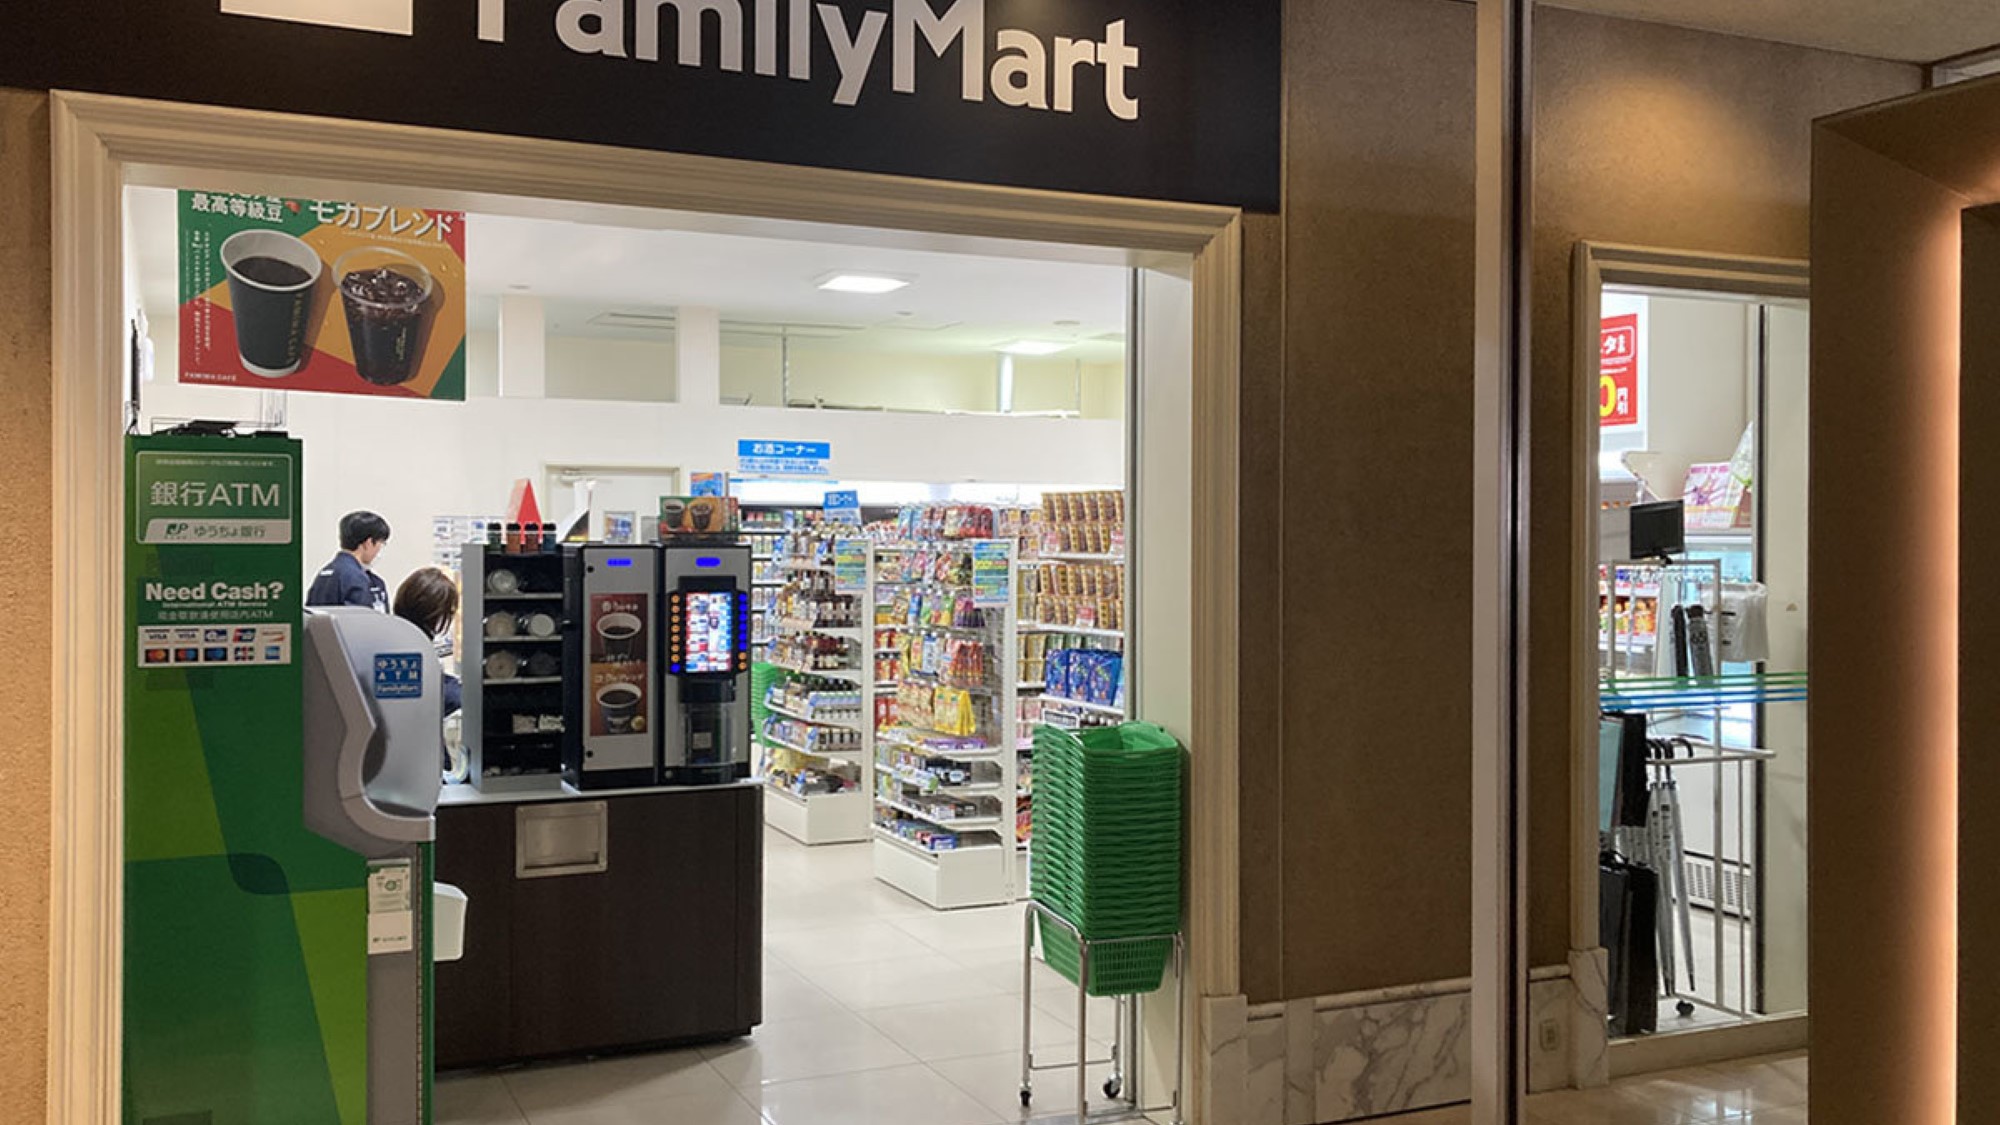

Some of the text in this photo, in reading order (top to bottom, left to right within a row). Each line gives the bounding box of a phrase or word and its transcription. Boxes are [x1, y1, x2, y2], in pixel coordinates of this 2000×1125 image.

[478, 0, 1139, 120] amilyMart
[309, 200, 453, 241] モカブレンド
[150, 481, 280, 507] 銀行ATM
[194, 525, 266, 538] ゆうちょ銀行
[145, 581, 284, 601] Need Cash?
[377, 684, 418, 695] FamilyMart
